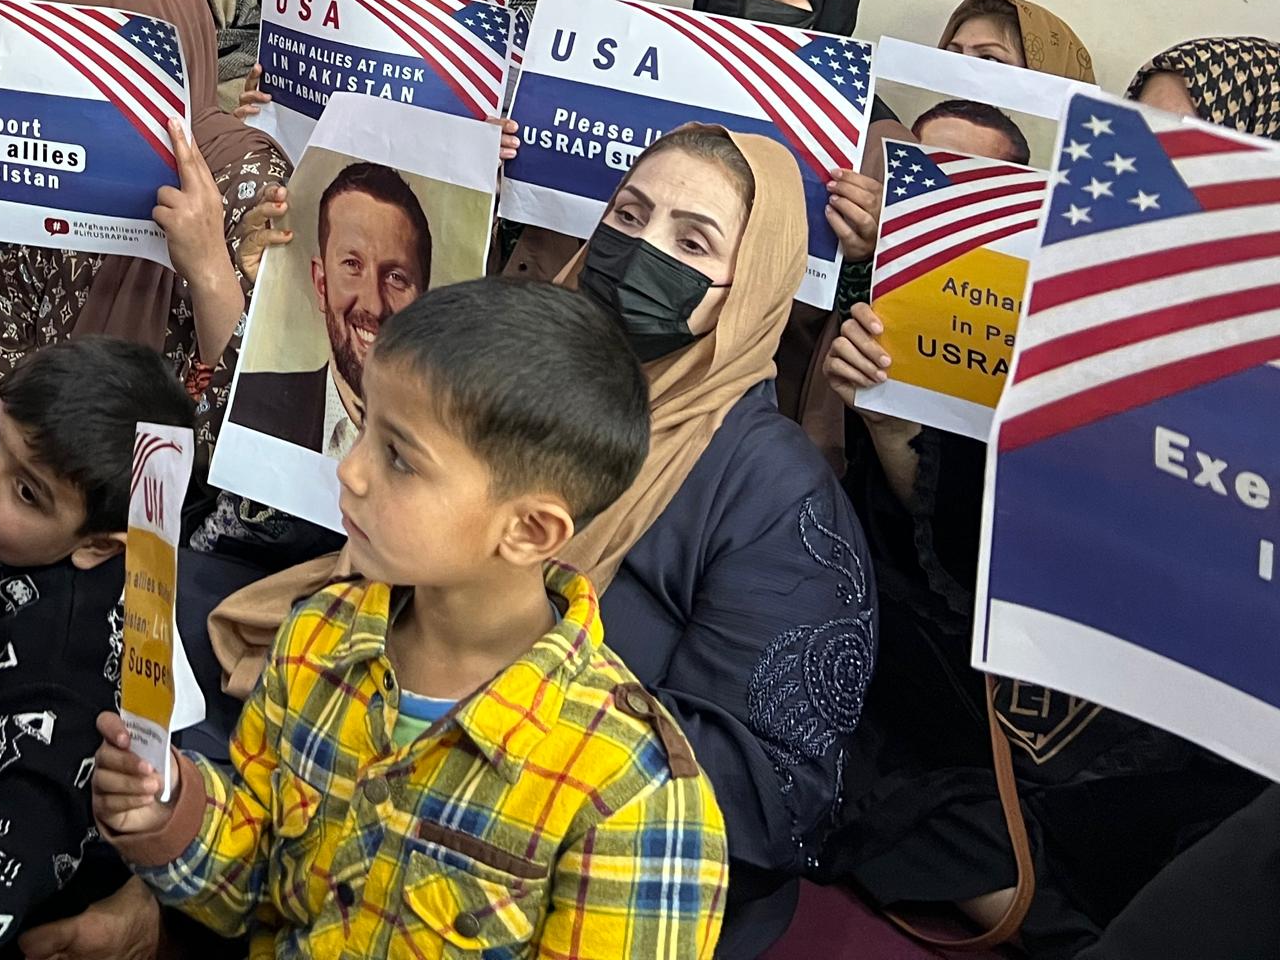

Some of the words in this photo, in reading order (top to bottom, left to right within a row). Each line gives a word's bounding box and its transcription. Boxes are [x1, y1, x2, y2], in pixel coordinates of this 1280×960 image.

[268, 32, 306, 56] AFGHAN
[309, 43, 352, 68] ALLIES
[358, 59, 376, 72] AT
[382, 64, 425, 82] RISK
[551, 28, 660, 80] USA
[264, 72, 292, 92] DON'T
[273, 53, 288, 70] IN
[299, 61, 415, 104] PAKISTAN
[523, 126, 602, 160] USRAP
[553, 108, 634, 144] Please
[8, 141, 79, 167] allies
